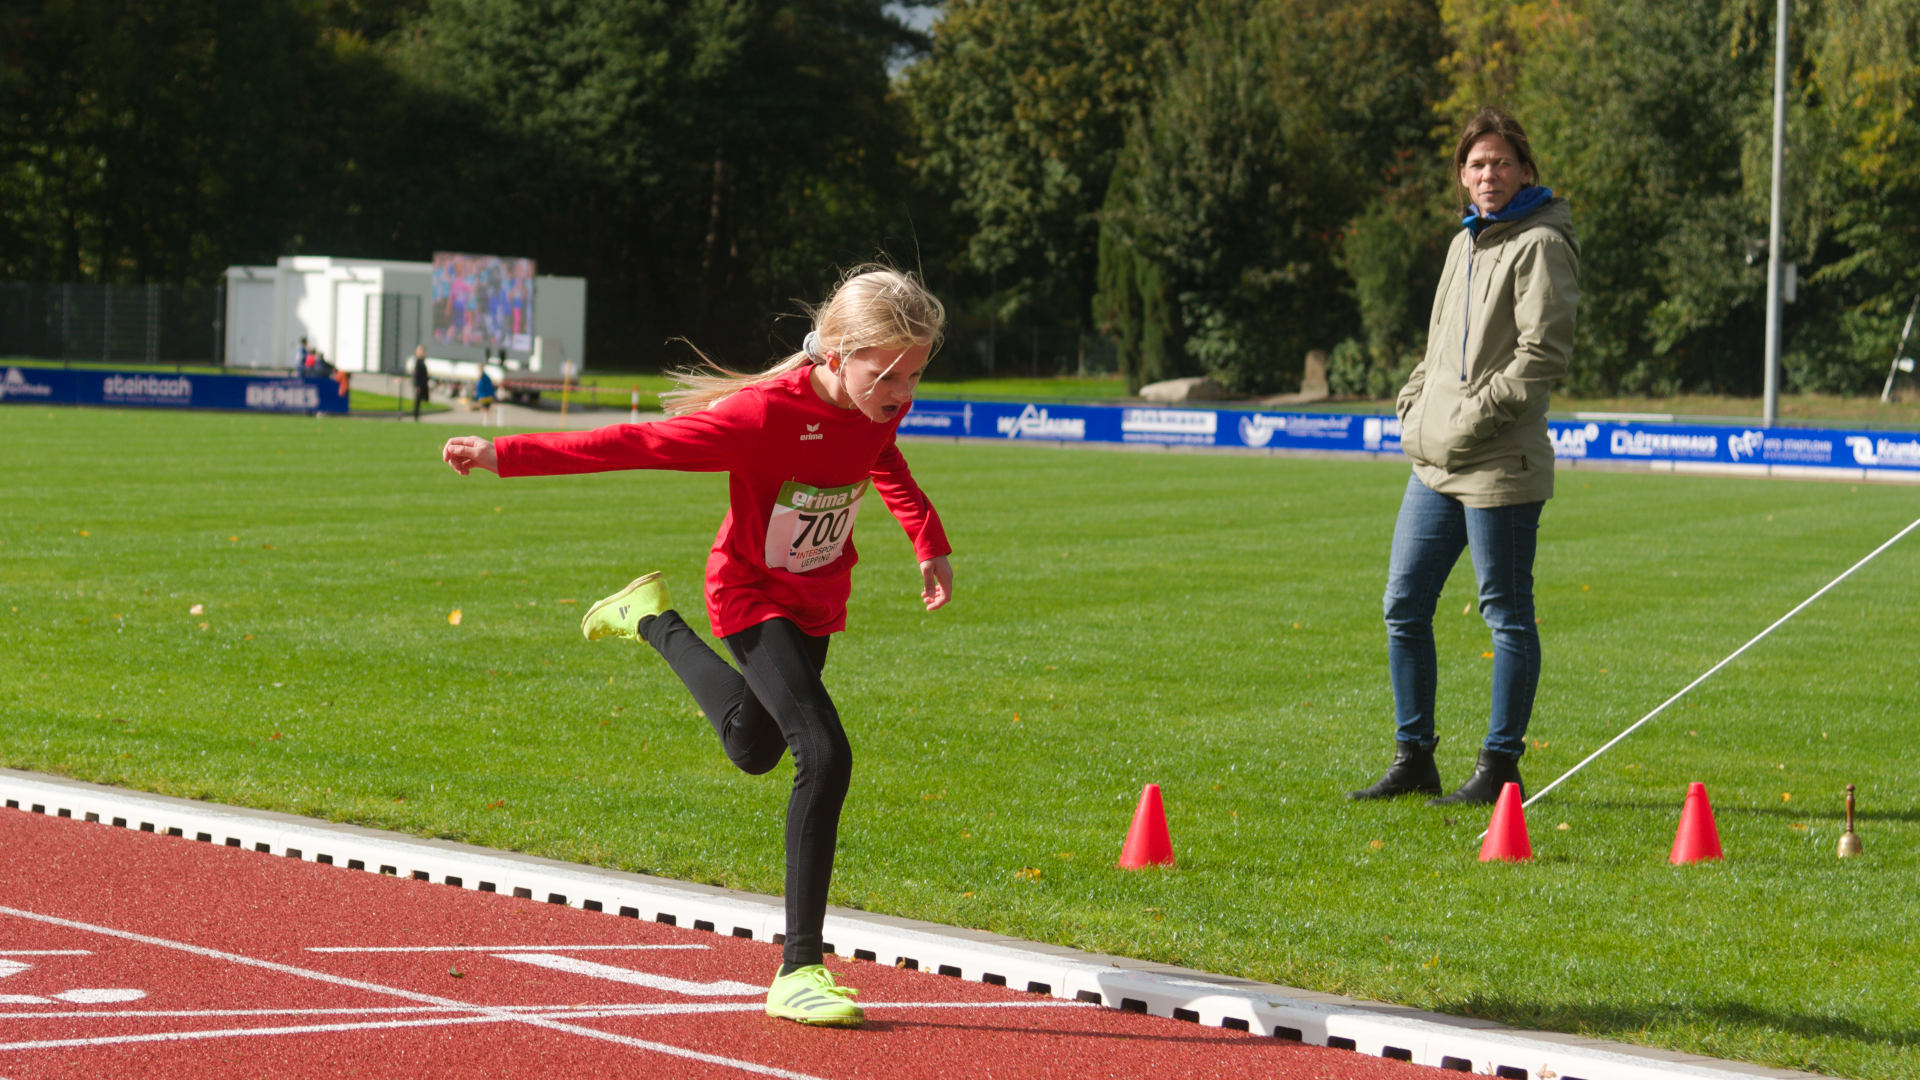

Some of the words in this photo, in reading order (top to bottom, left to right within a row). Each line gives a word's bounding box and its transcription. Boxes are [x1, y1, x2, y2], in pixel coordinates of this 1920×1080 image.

[103, 374, 192, 396] steinbach
[800, 433, 824, 441] erima
[791, 491, 849, 509] erima
[792, 508, 850, 549] 700
[795, 541, 840, 559] INTERSPORT
